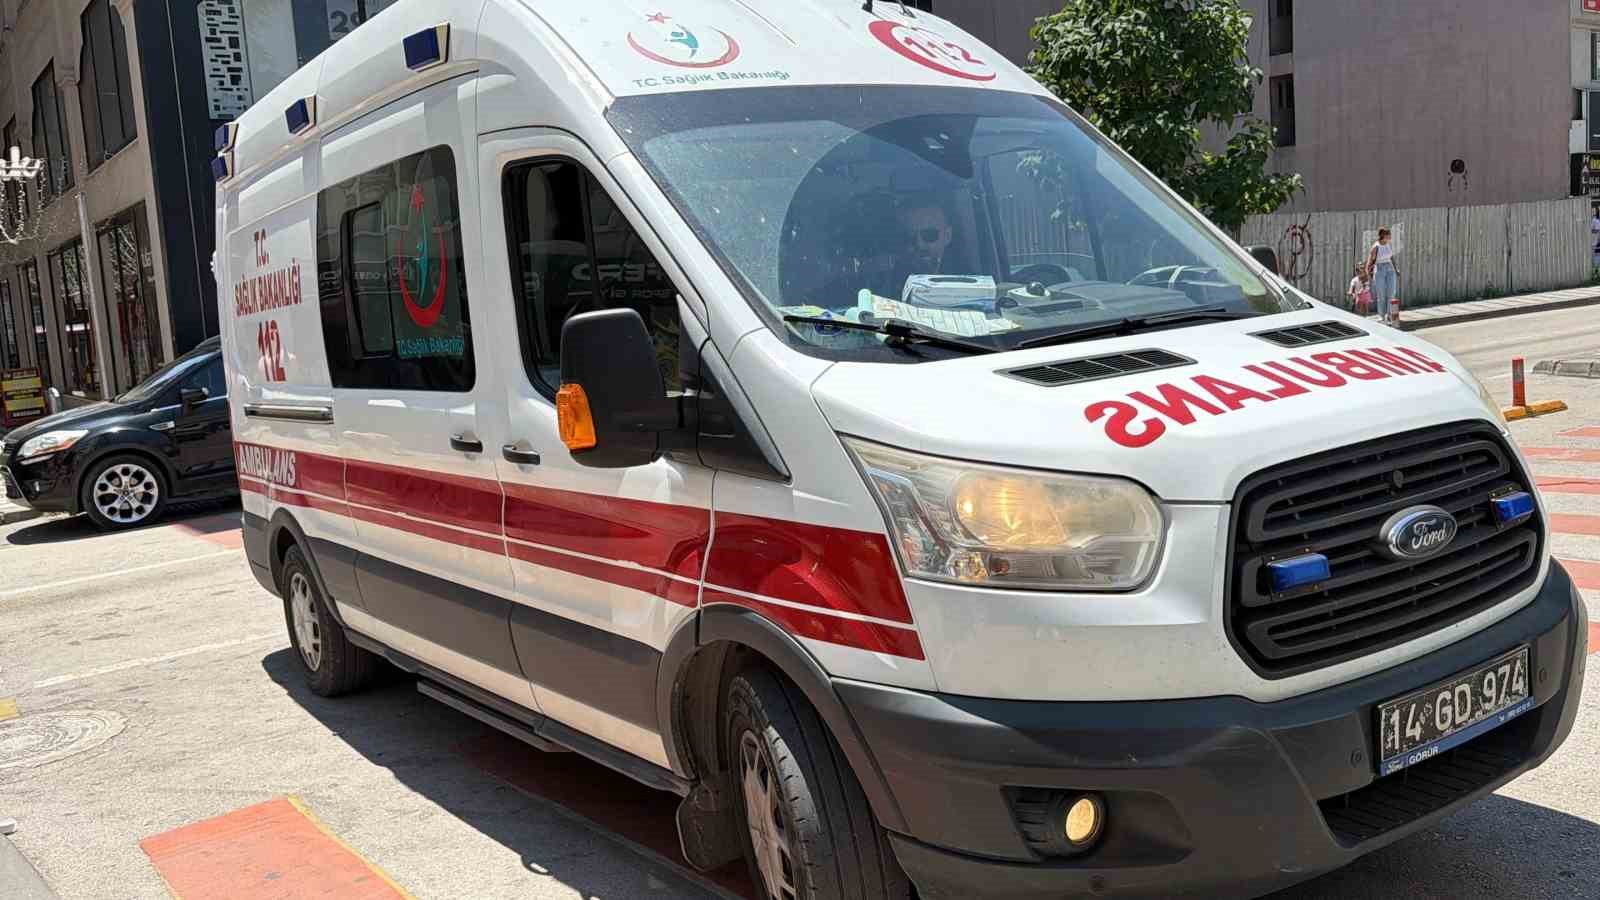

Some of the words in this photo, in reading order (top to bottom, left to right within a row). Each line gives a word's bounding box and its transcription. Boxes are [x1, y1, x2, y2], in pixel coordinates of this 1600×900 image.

[903, 35, 986, 65] 112
[254, 228, 269, 268] T.C.
[235, 274, 259, 316] SAĞLIK
[257, 320, 286, 382] 112
[240, 444, 296, 486] AMBULANS
[1411, 518, 1446, 549] Ford
[1387, 703, 1422, 750] 14
[1435, 683, 1472, 731] GD
[1480, 659, 1525, 710] 974
